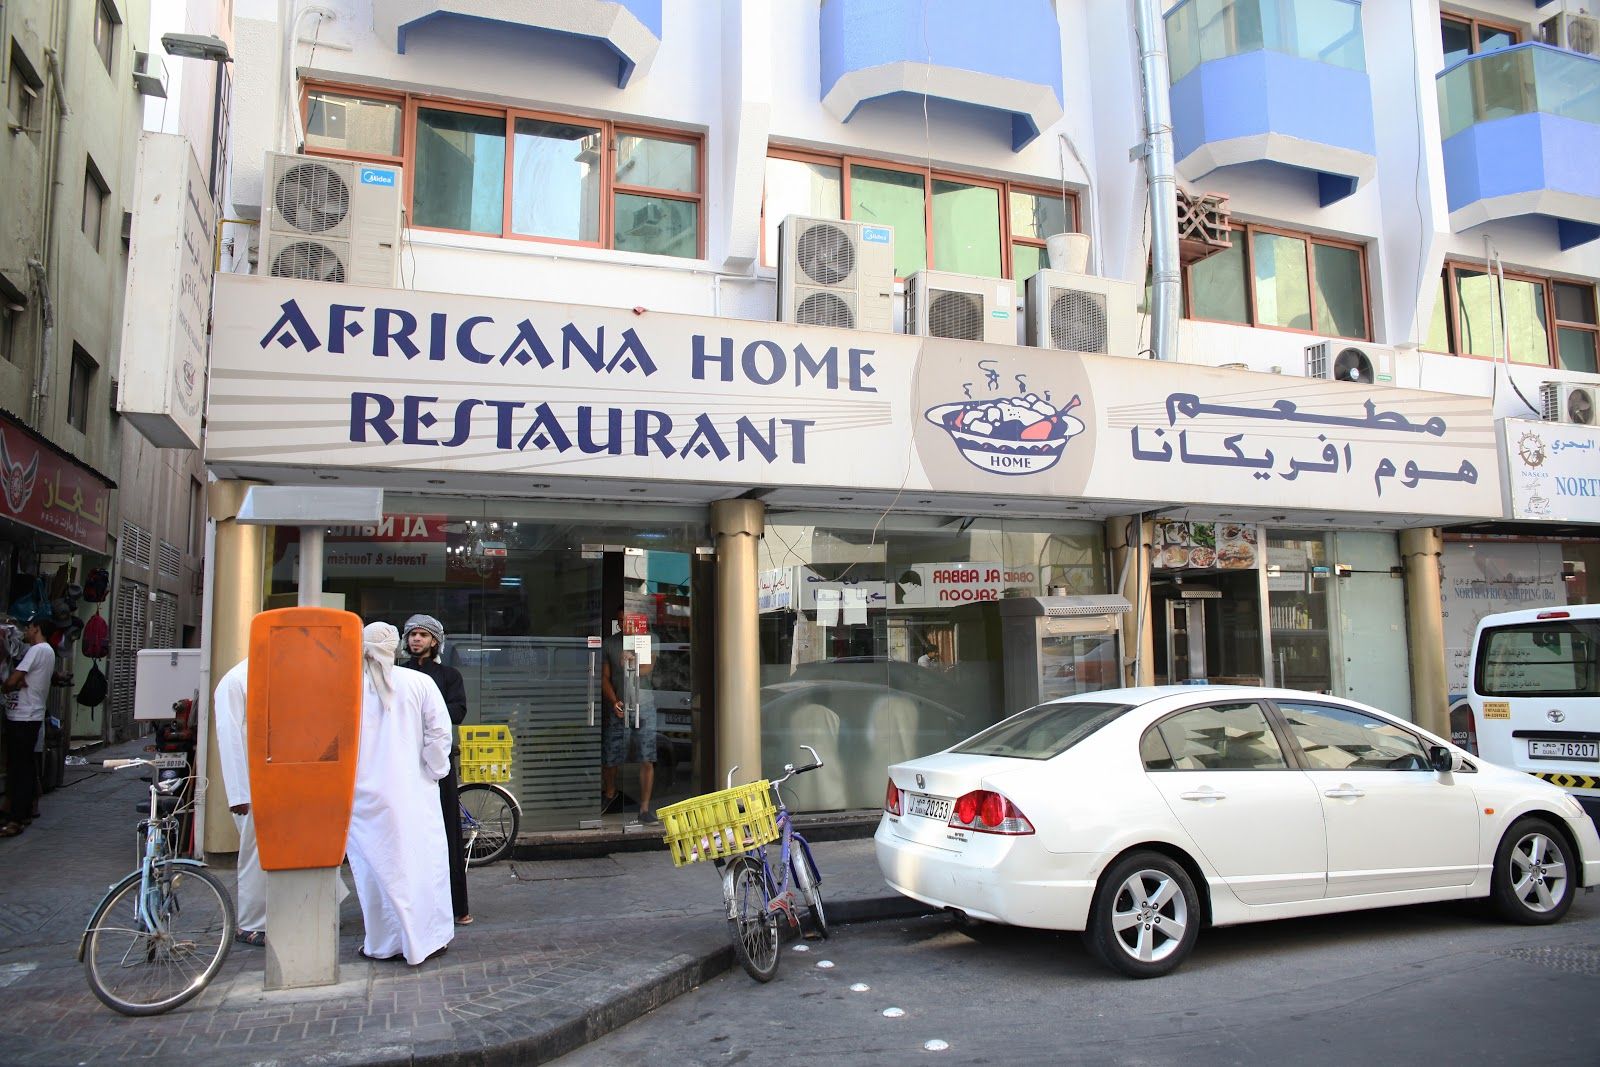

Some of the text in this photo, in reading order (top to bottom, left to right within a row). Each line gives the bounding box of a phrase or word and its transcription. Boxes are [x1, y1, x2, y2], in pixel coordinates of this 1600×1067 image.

[364, 171, 393, 183] Midea
[259, 299, 656, 376] AFRICANA
[691, 334, 877, 393] HOME
[1166, 392, 1447, 438] مطعم
[349, 392, 815, 464] RESTAURANT
[1551, 439, 1595, 455] البحري
[990, 456, 1032, 469] HOME
[1130, 424, 1479, 498] هوم افريكانا
[1521, 470, 1549, 478] NASCO
[1555, 476, 1600, 497] NORT
[1532, 743, 1595, 757] F 76207
[925, 800, 949, 819] 20253
